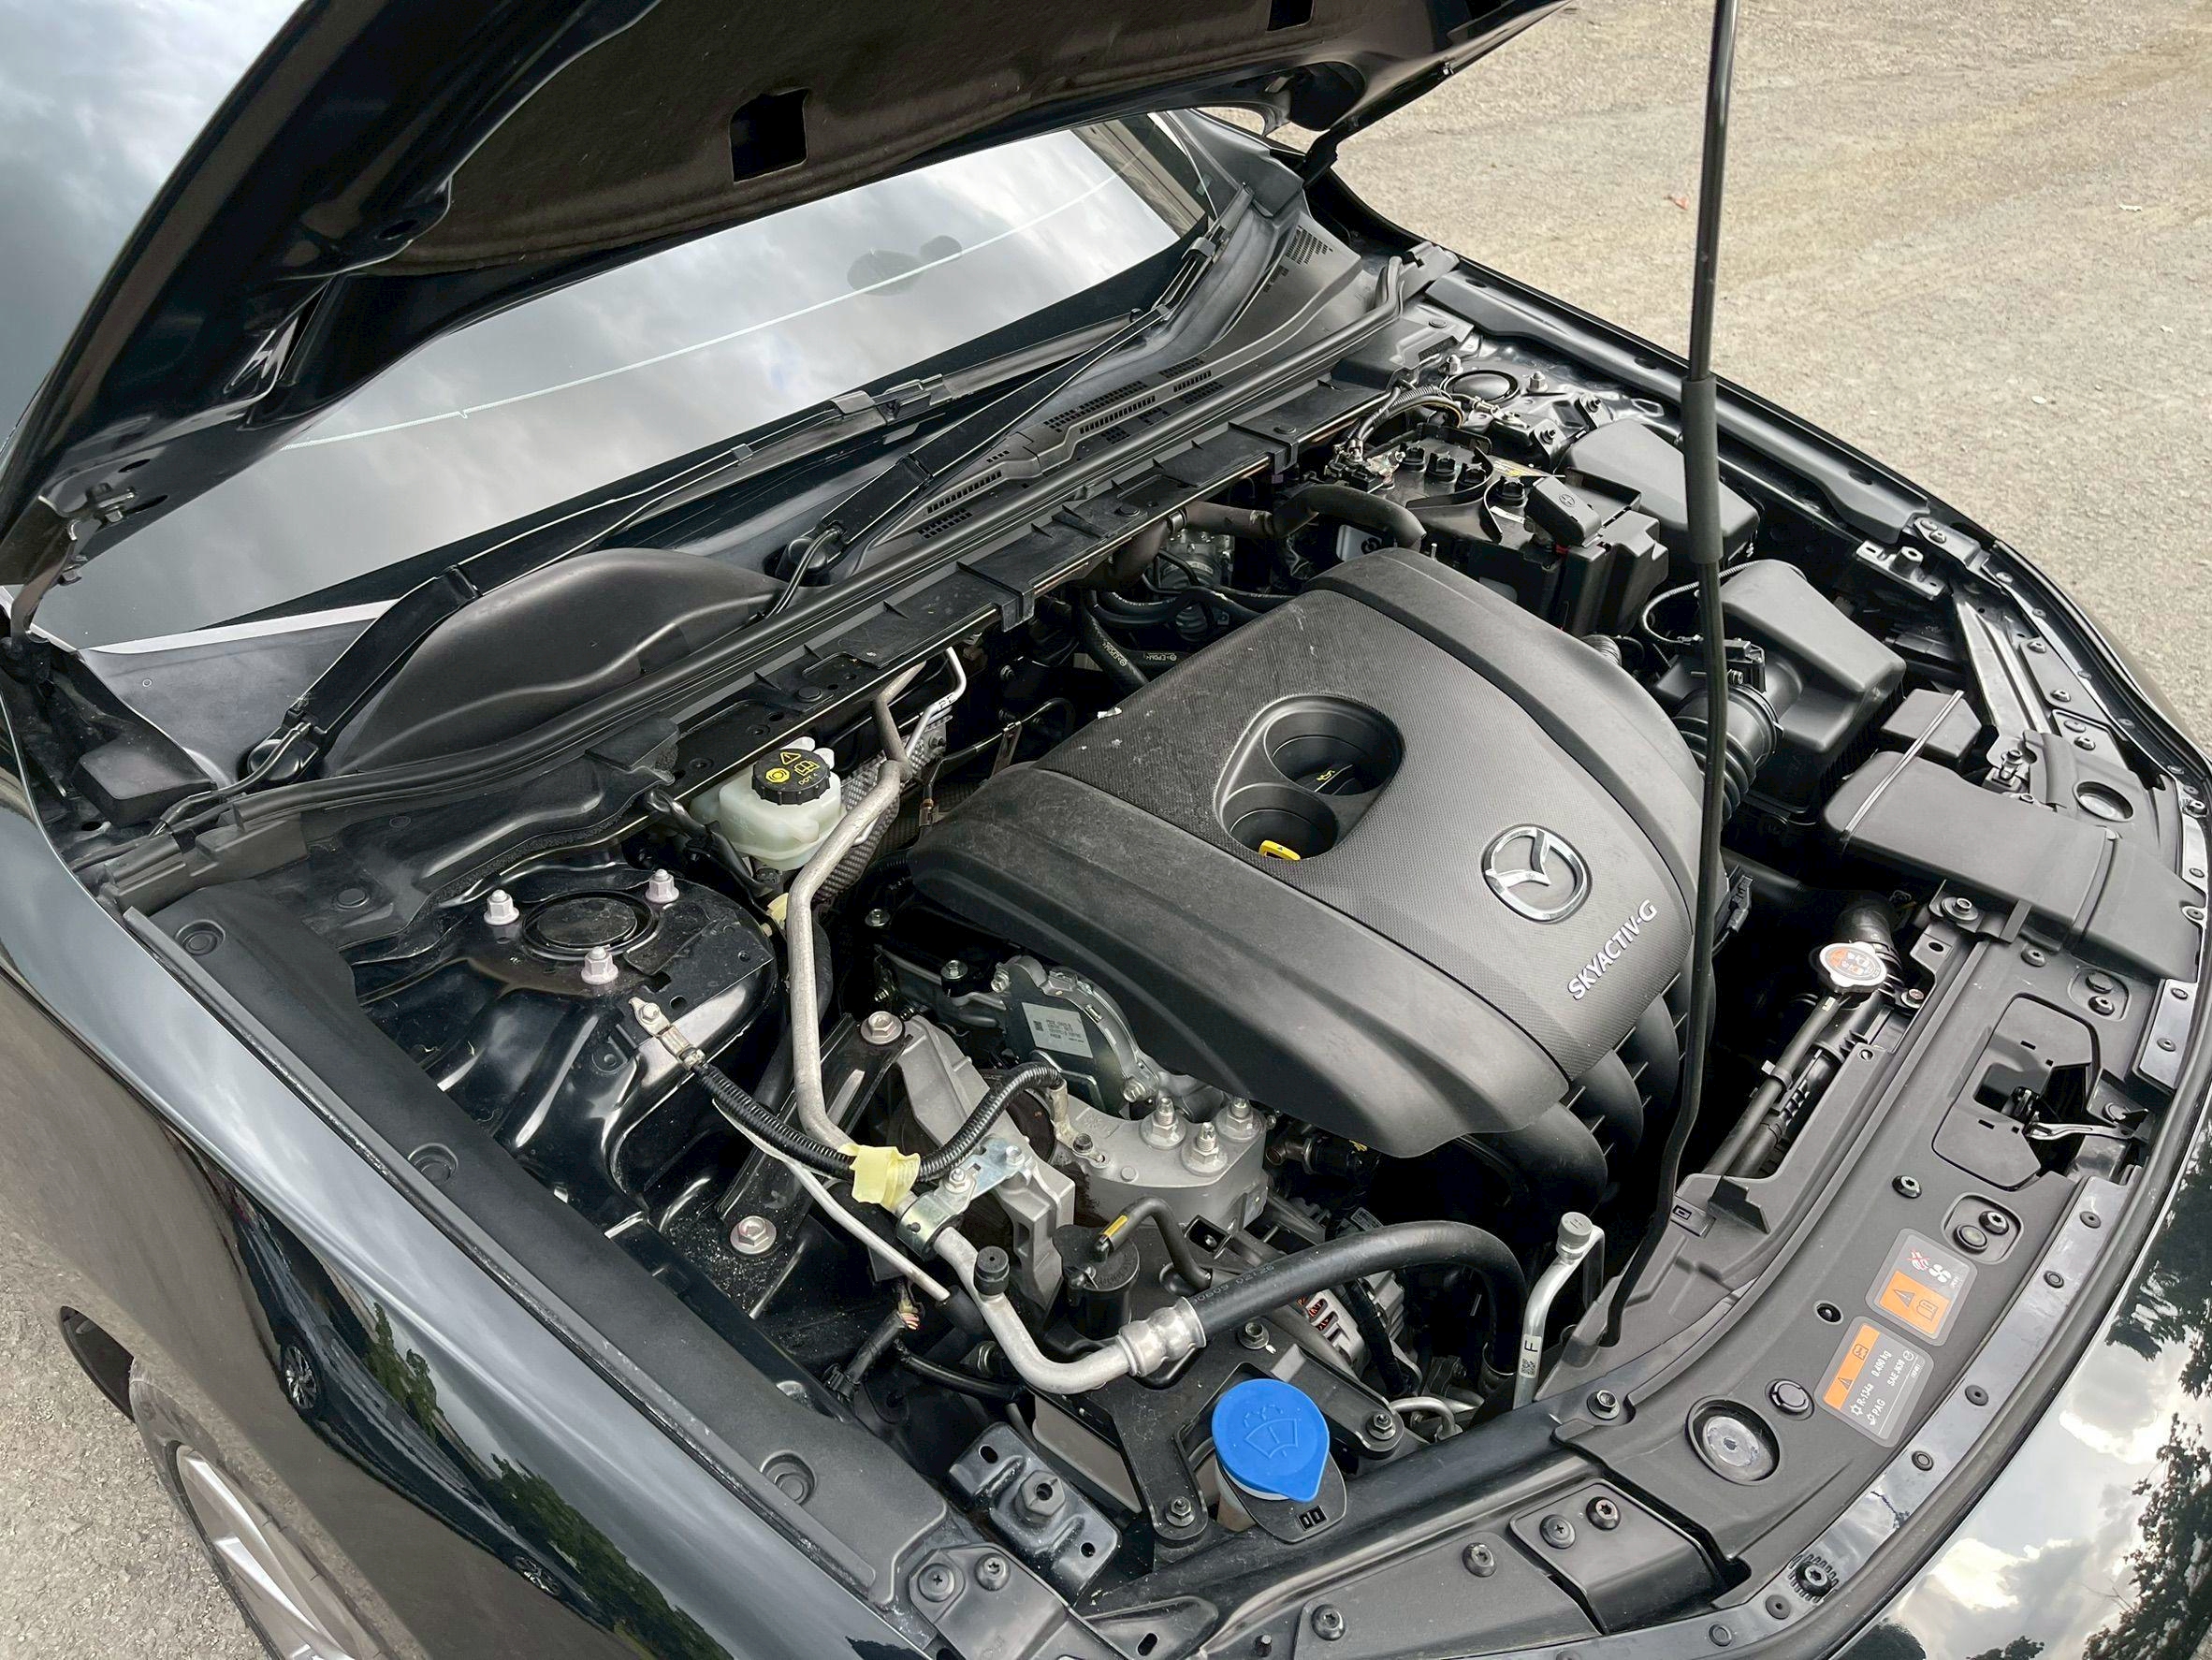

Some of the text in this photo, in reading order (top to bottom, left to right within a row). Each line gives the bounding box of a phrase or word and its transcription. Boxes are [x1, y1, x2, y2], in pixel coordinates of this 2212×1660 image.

[798, 775, 812, 785] DOT
[1567, 898, 1659, 1000] SKYACTIV-G
[1524, 1340, 1538, 1352] F
[1856, 1383, 1874, 1406] R-134a
[1871, 1359, 1885, 1376] 0.490
[1871, 1399, 1885, 1416] PAG
[1887, 1372, 1899, 1386] SAE
